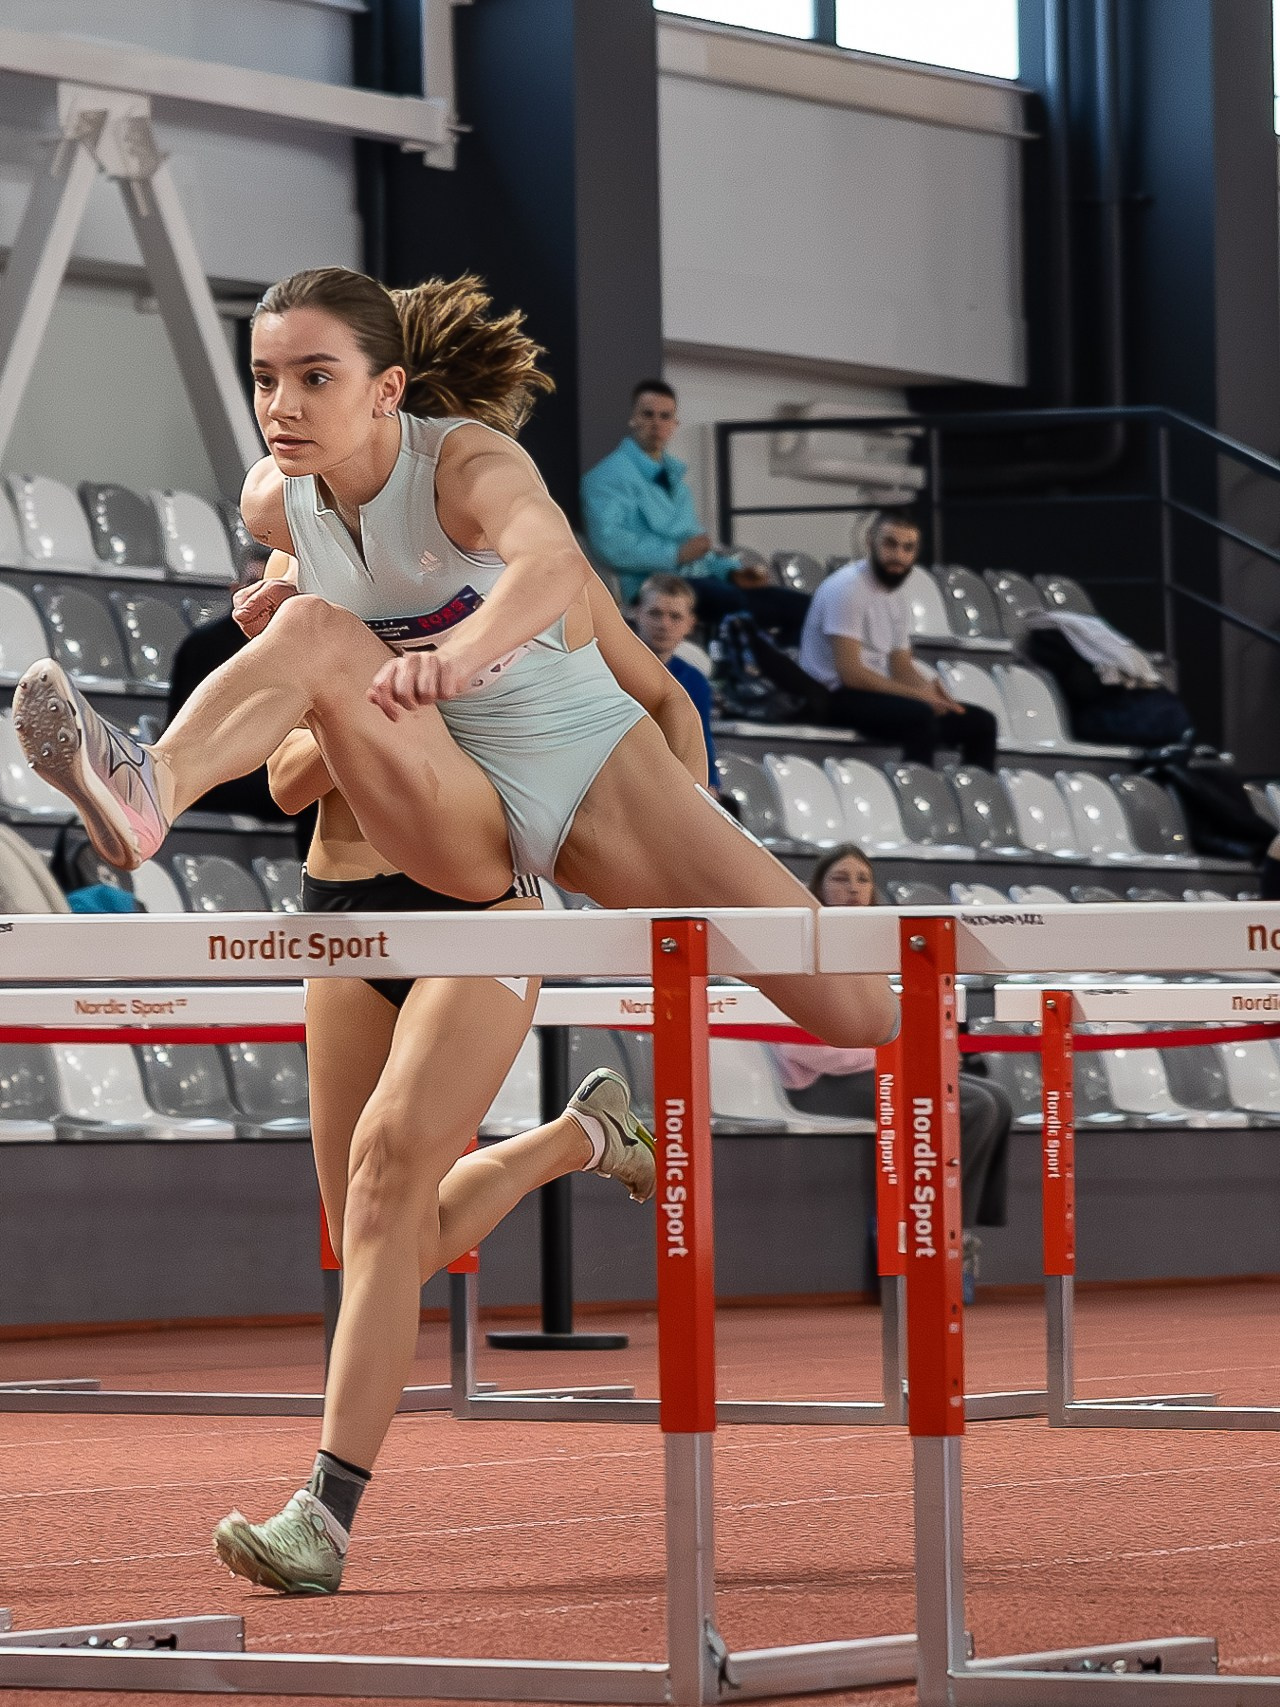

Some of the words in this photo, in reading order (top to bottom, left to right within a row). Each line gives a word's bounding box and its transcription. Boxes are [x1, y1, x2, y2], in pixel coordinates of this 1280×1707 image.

[308, 931, 390, 966] Sport
[74, 999, 127, 1015] Nordic
[131, 999, 175, 1018] Sport
[661, 1185, 689, 1258] Sport
[909, 1185, 938, 1258] Sport
